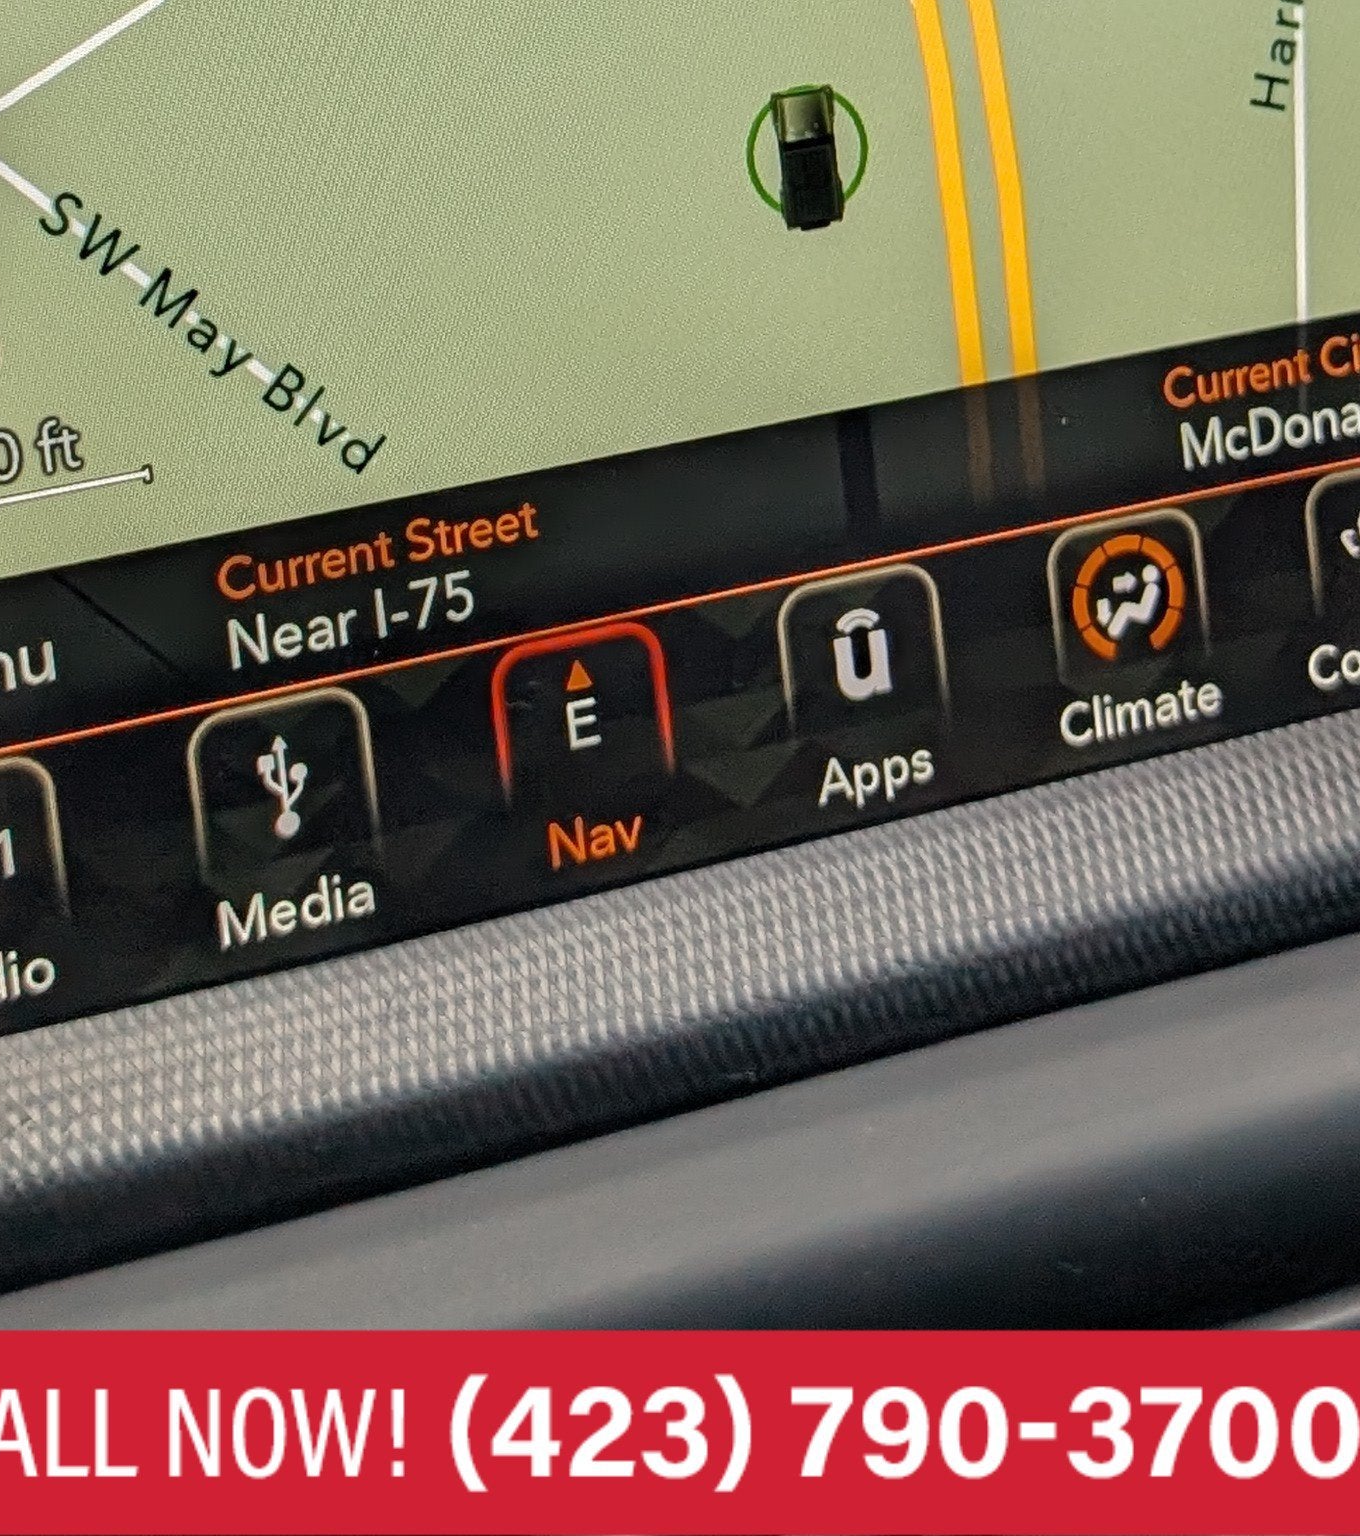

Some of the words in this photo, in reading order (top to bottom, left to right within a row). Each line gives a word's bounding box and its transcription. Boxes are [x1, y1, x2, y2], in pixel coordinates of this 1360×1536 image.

[40, 192, 140, 275] SW
[139, 268, 254, 378] May
[264, 363, 386, 474] Blvd
[1164, 348, 1310, 410] Current
[35, 418, 83, 473] ft
[217, 529, 395, 601] Current
[406, 502, 539, 563] Street
[227, 608, 358, 668] Near
[375, 570, 475, 638] I-75
[566, 697, 602, 750] E
[1060, 676, 1223, 748] Climate
[817, 745, 935, 808] Apps
[548, 816, 642, 871] Nav
[216, 873, 376, 950] Media
